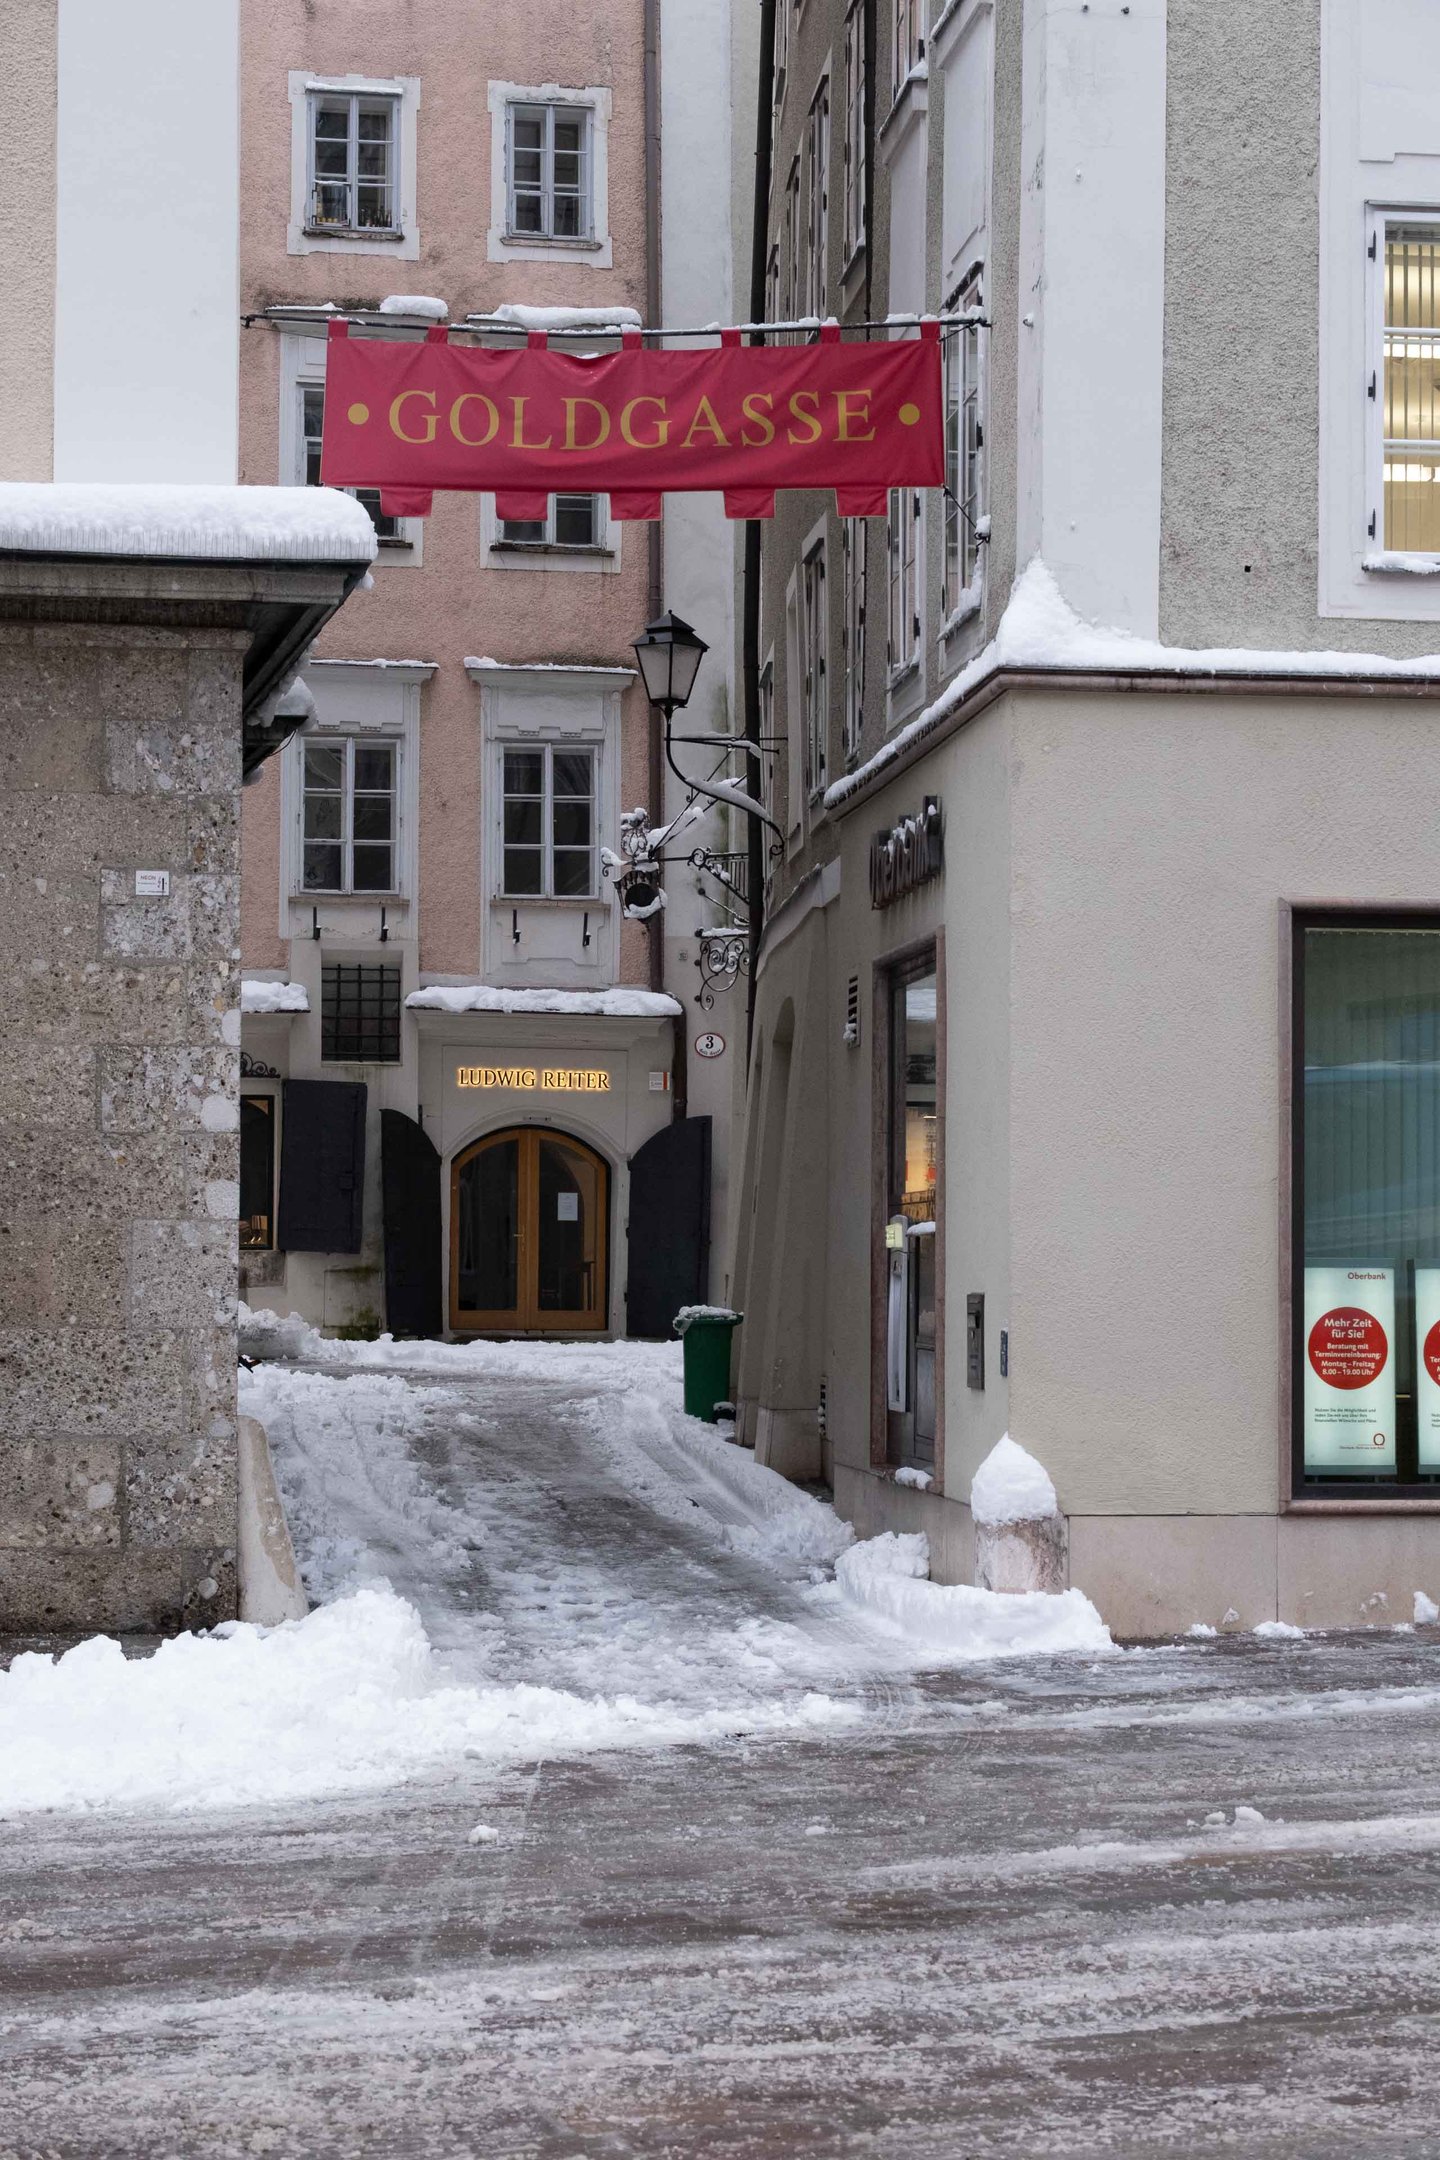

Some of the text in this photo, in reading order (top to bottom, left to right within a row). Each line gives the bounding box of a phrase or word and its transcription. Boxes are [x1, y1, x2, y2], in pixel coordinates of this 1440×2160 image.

[388, 388, 876, 451] GOLDGASSE
[705, 1035, 714, 1049] 3
[459, 1068, 610, 1089] LUDWIG REITER
[1347, 1272, 1386, 1280] Oberbank
[1324, 1318, 1372, 1328] Mehr Zeit
[1331, 1329, 1365, 1339] für Sie!
[1327, 1342, 1357, 1351] Beratung
[1321, 1360, 1347, 1369] Montag
[1352, 1361, 1376, 1369] Freitag
[1361, 1368, 1374, 1376] Uhr
